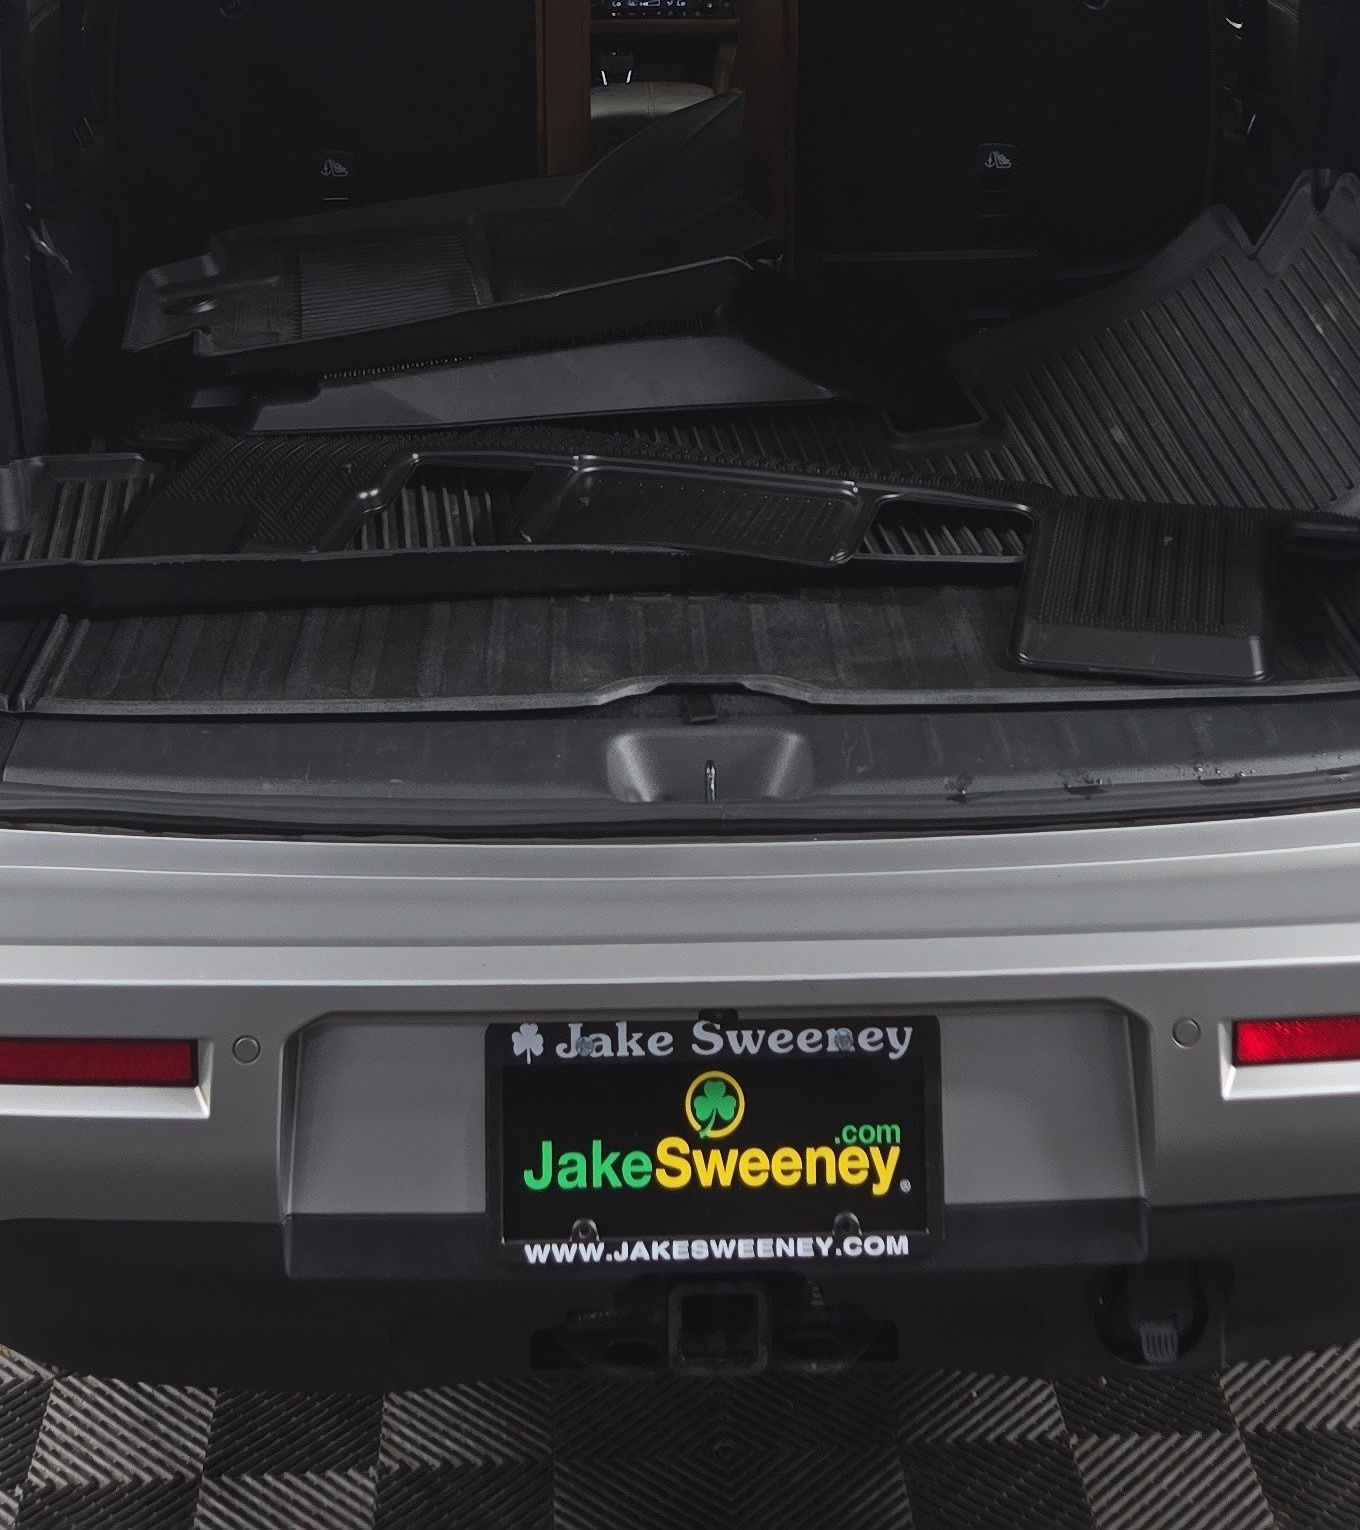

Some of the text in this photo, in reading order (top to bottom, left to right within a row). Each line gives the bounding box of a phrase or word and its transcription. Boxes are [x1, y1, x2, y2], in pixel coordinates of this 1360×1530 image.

[555, 1020, 913, 1060] Jake Sweeney
[523, 1235, 910, 1265] WWW.JAKESWEENEY.COM
